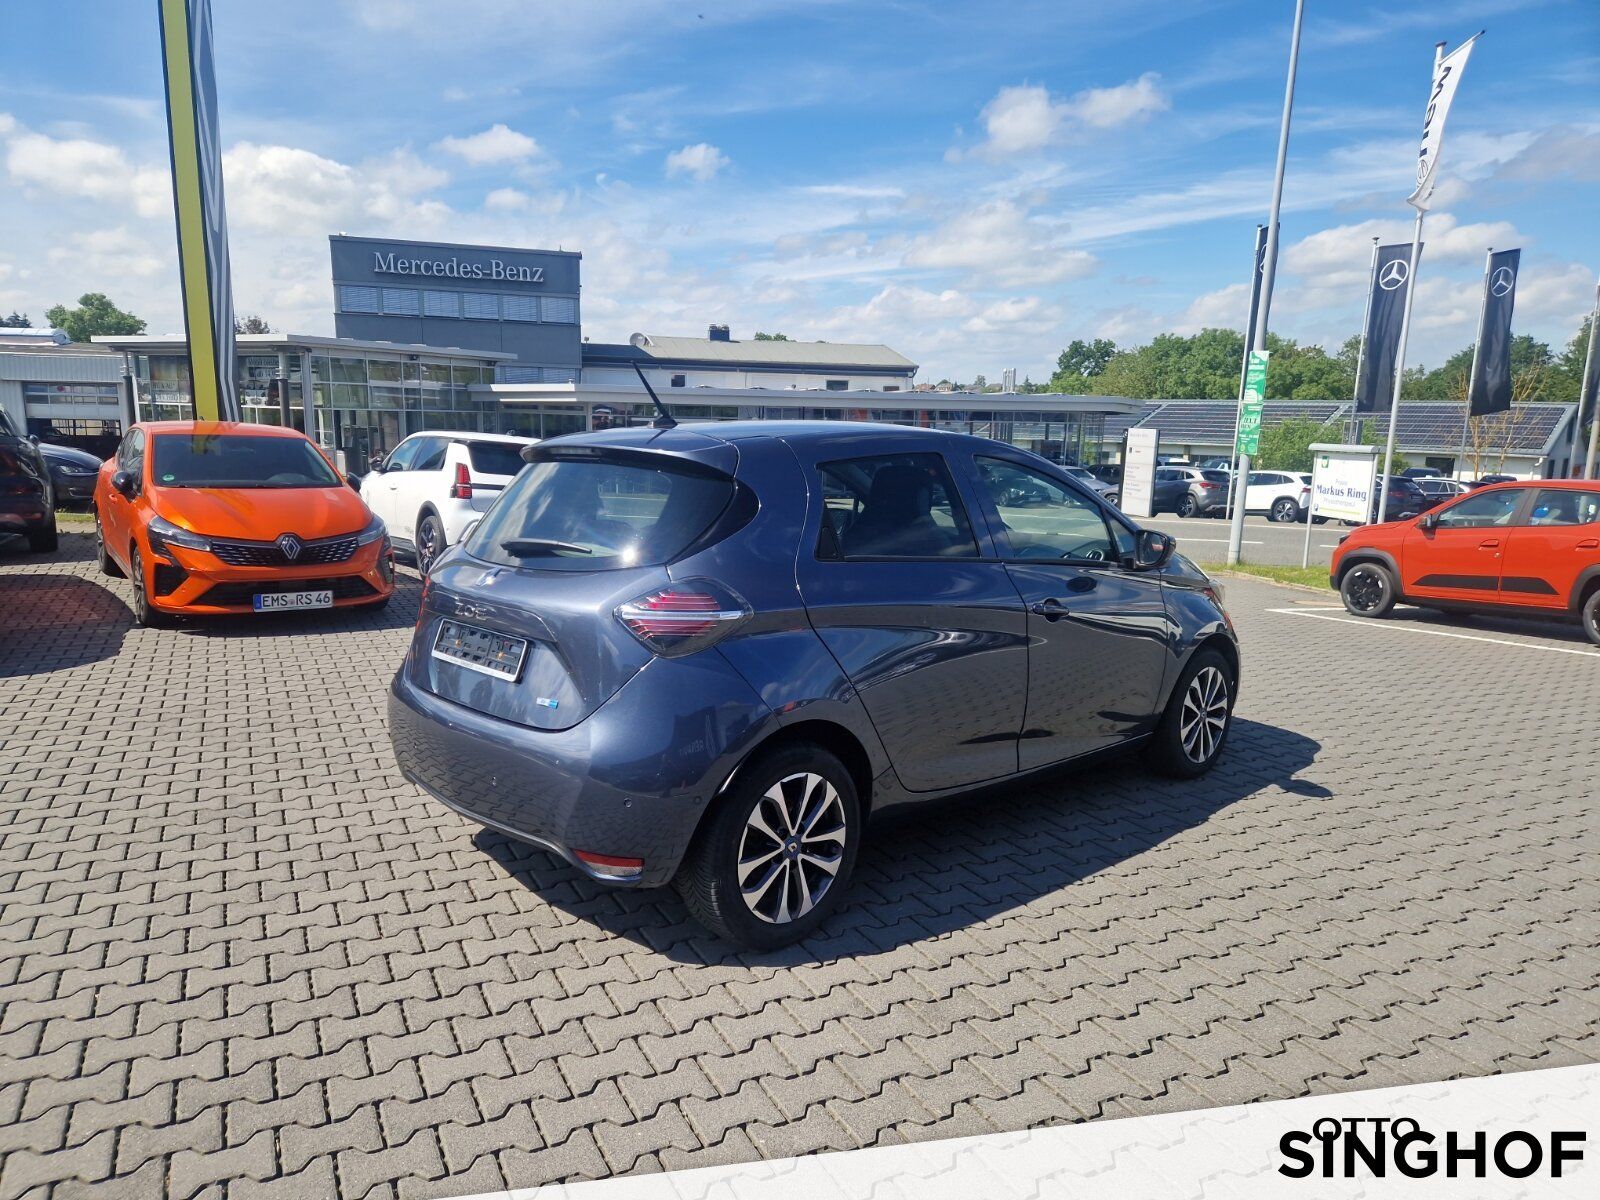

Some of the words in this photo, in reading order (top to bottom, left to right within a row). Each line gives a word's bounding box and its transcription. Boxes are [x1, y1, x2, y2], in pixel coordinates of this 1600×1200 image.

[373, 252, 544, 282] Mercedes-Benz
[1316, 484, 1345, 497] Markus
[1347, 487, 1367, 501] Ring
[262, 595, 288, 607] EMS
[296, 593, 313, 605] RS
[315, 592, 331, 604] 46
